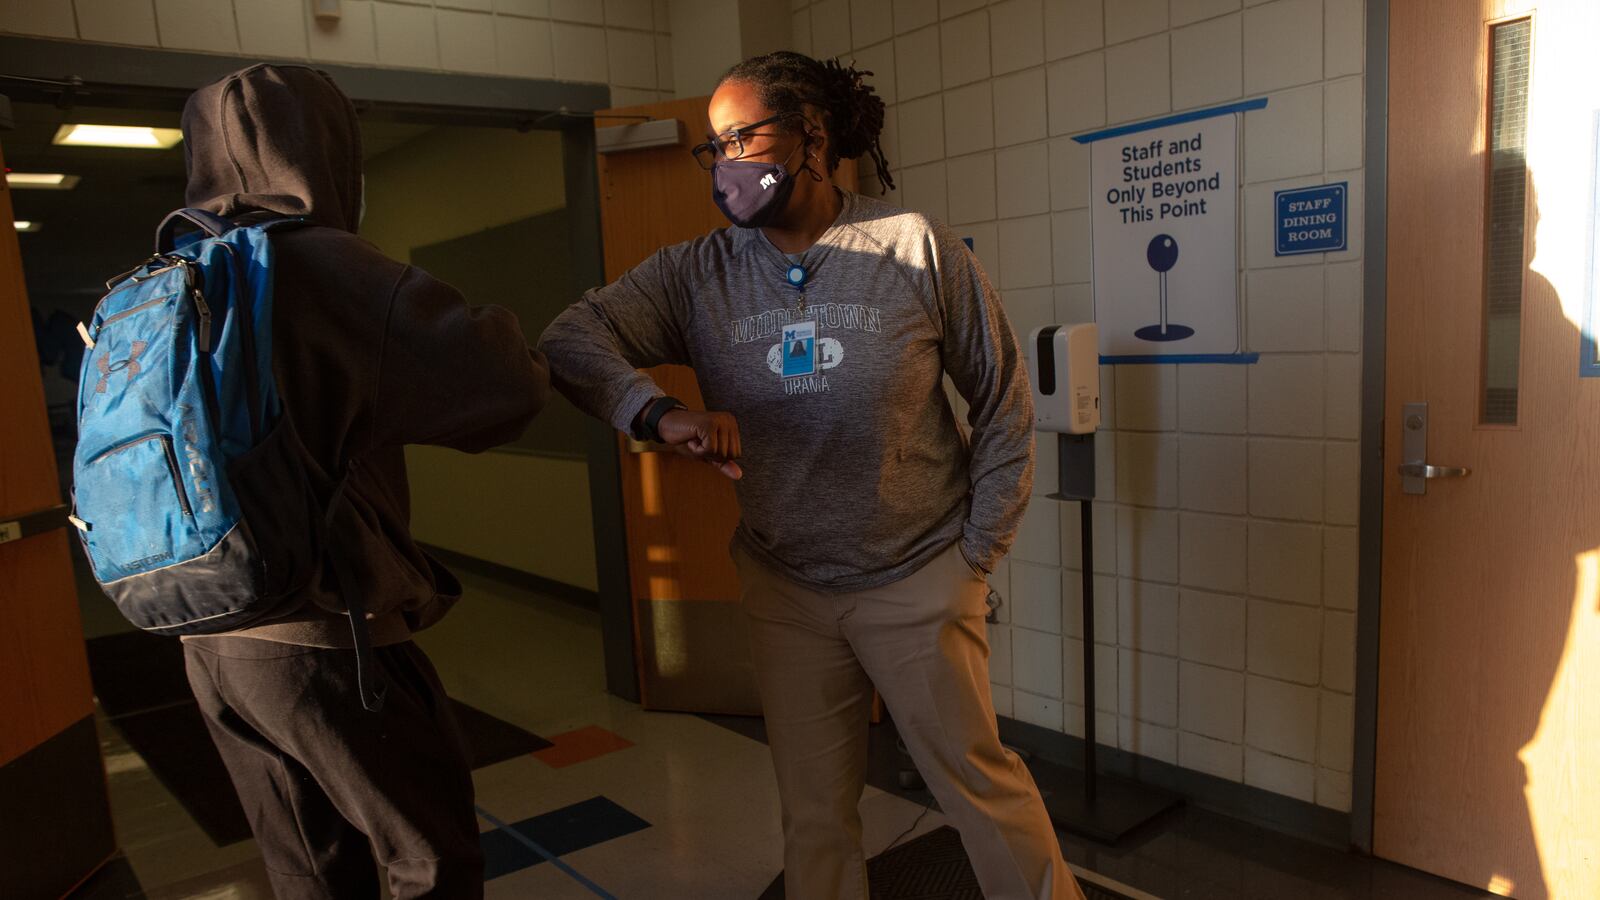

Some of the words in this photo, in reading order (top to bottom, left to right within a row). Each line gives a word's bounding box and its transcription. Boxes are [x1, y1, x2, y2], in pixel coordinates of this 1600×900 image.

[1121, 140, 1164, 164] Staff
[1168, 132, 1203, 155] and
[1122, 157, 1202, 183] Students
[759, 173, 777, 190] M
[1106, 183, 1145, 206] Only
[1152, 172, 1220, 199] Beyond
[1119, 205, 1154, 225] This
[1160, 197, 1207, 219] Point
[1287, 198, 1332, 213] STAFF
[1283, 213, 1337, 229] DINING
[1288, 228, 1332, 243] ROOM
